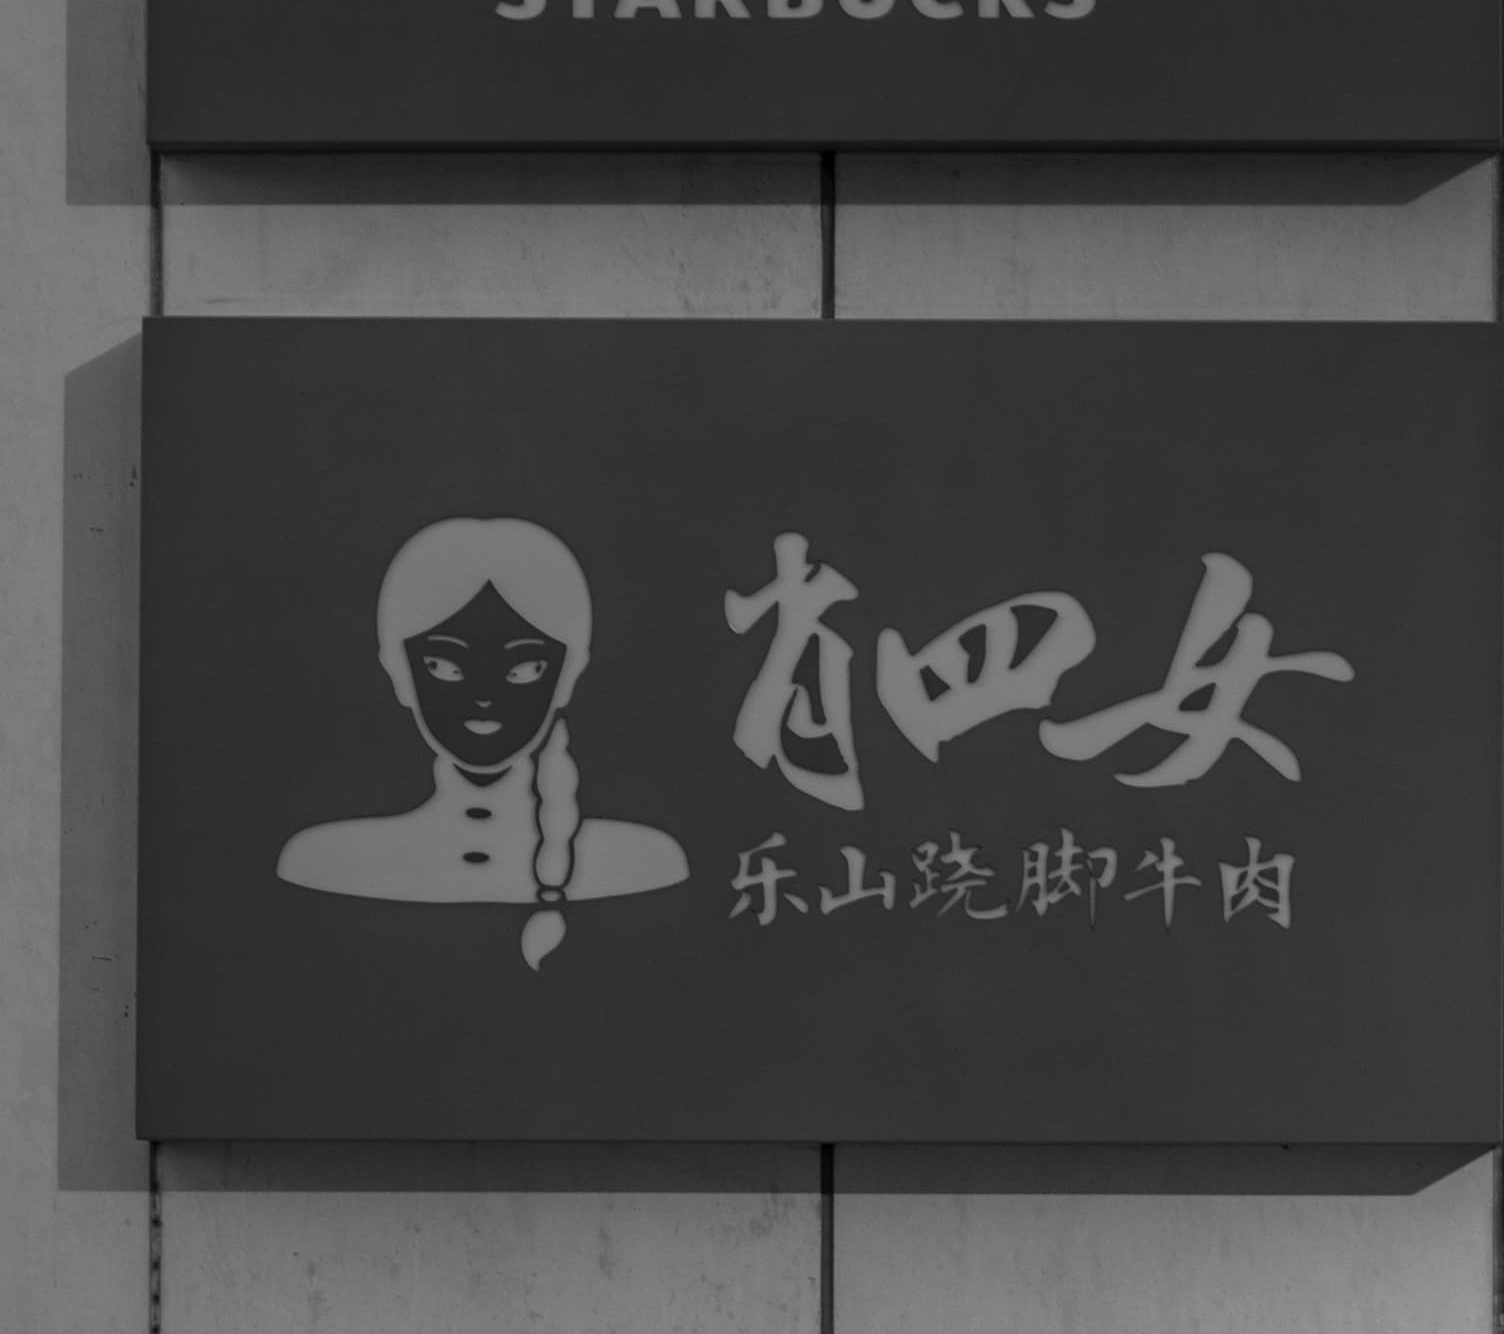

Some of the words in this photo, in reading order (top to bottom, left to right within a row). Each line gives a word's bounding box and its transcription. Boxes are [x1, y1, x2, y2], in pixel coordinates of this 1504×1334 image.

[726, 828, 1296, 935] 乐山跷脚牛肉
